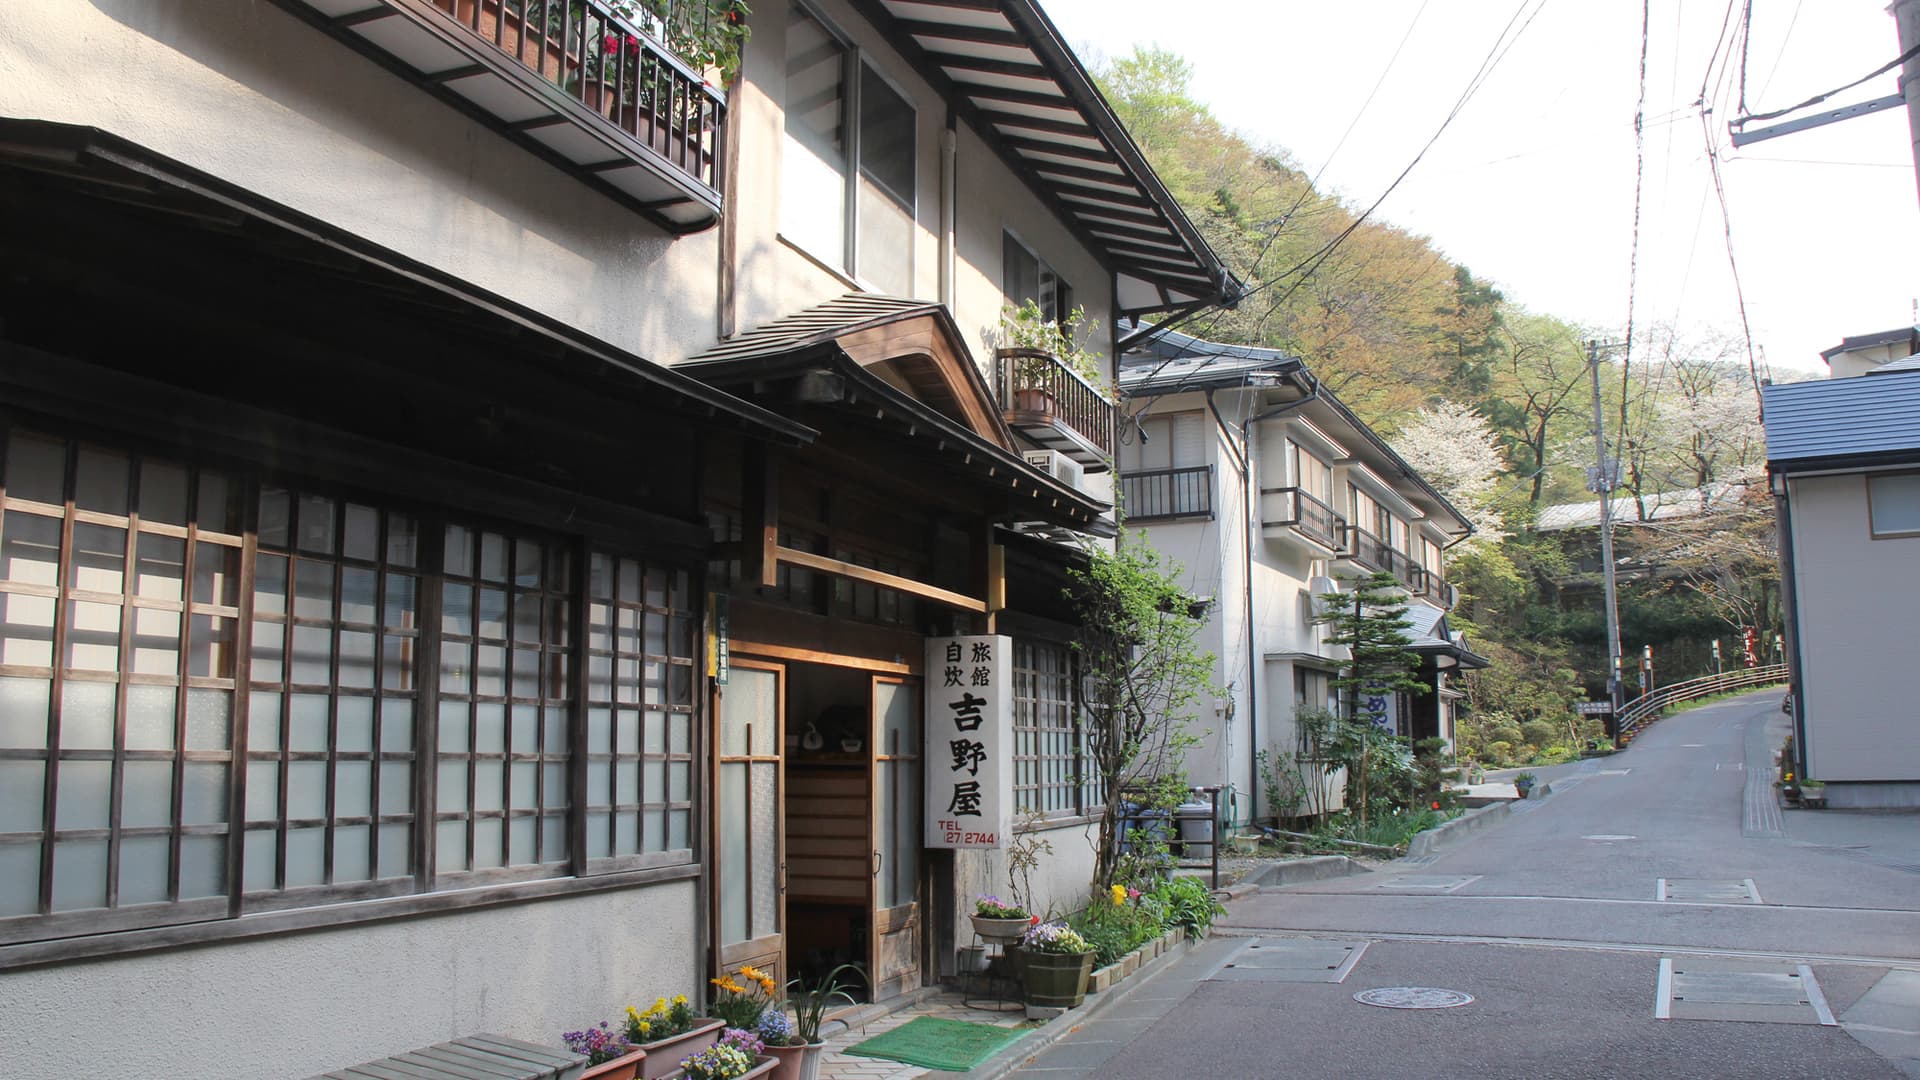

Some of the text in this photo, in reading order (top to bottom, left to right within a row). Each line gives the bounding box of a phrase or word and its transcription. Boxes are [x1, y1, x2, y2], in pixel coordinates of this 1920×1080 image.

[944, 641, 965, 688] 自炊
[970, 642, 992, 687] 旅館
[947, 692, 988, 817] 吉野屋
[938, 820, 962, 831] TEL
